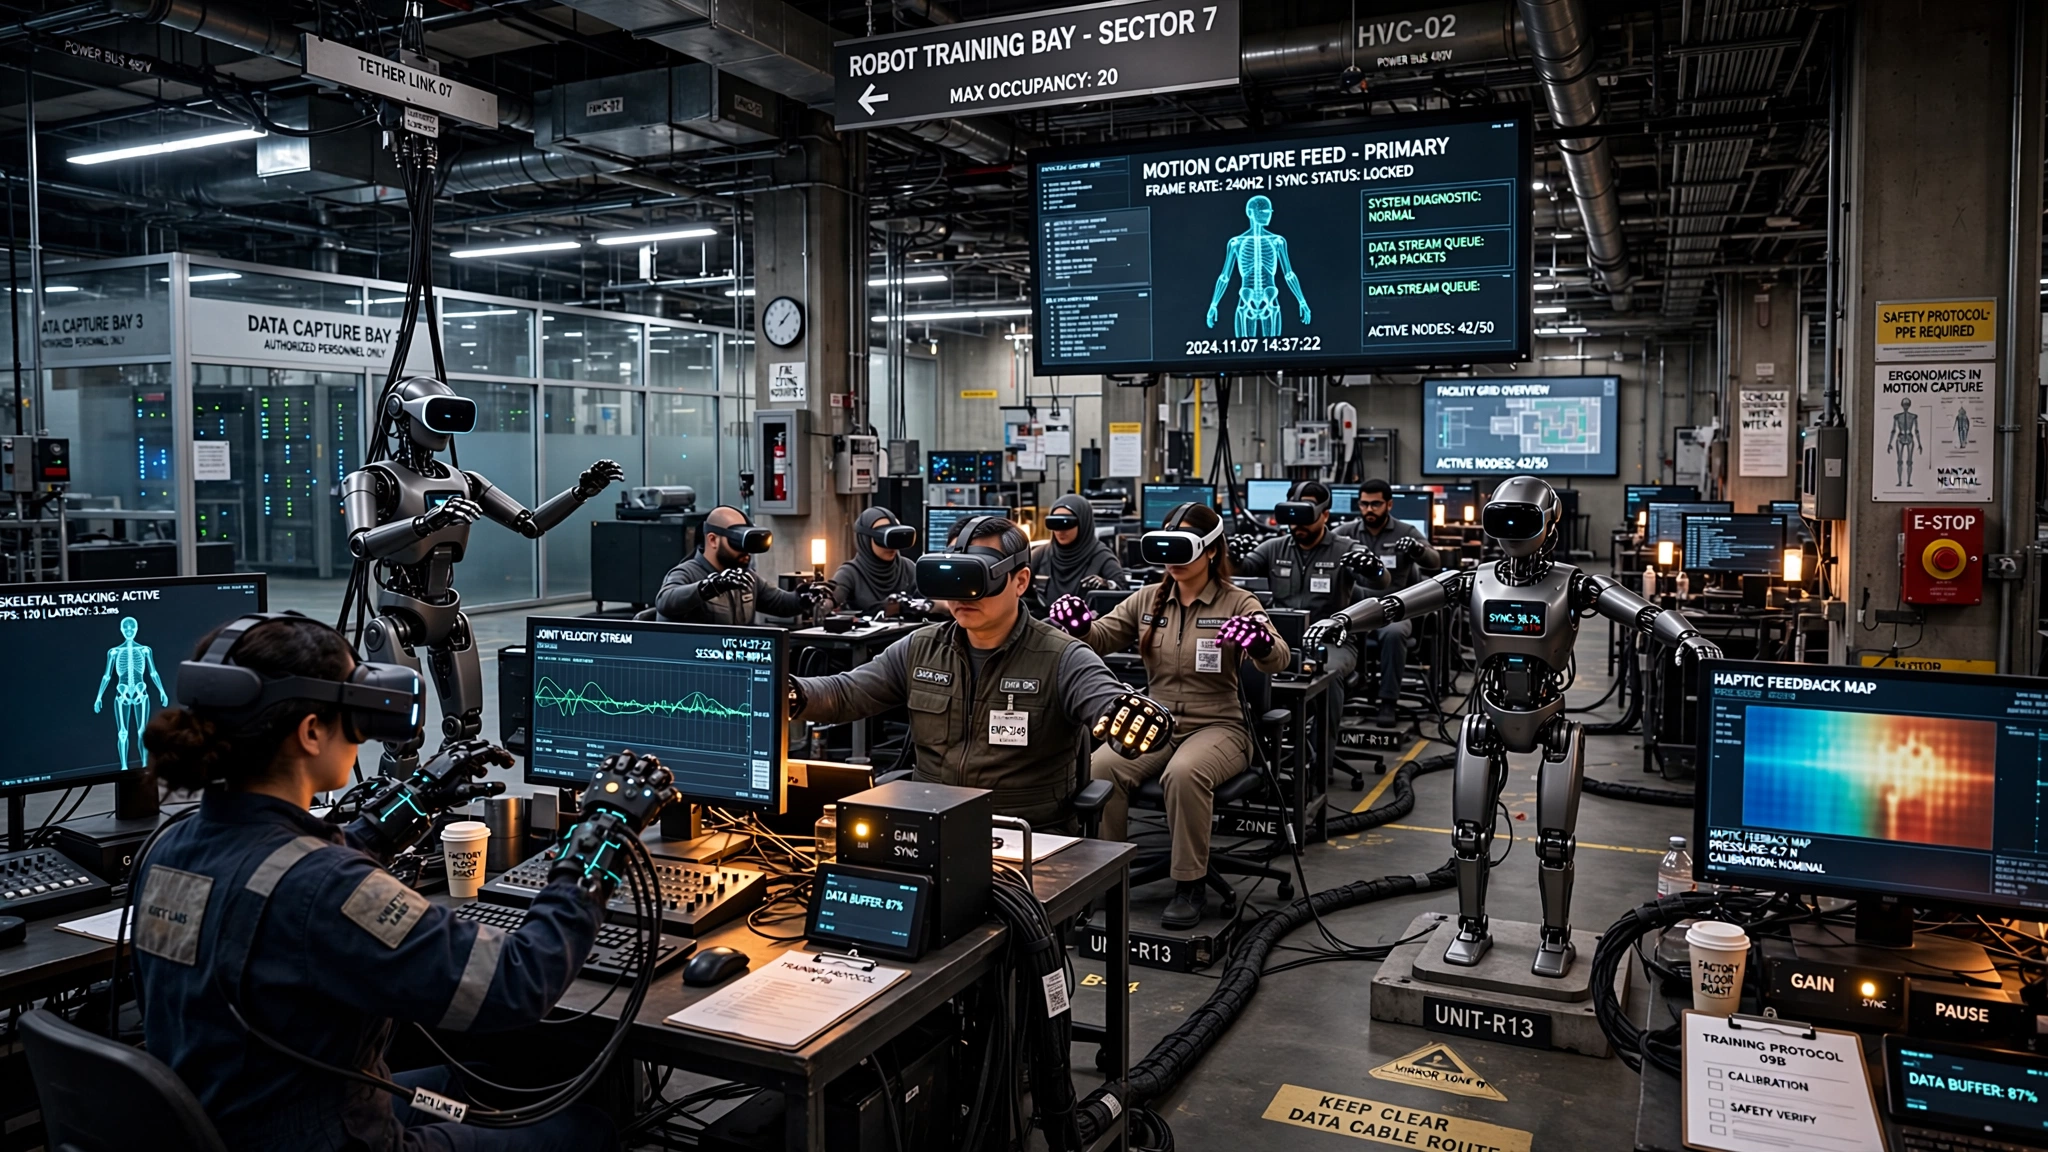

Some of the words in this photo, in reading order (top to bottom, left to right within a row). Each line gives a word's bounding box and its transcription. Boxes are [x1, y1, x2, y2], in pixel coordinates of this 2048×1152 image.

[1358, 14, 1456, 48] HVC-02
[849, 46, 918, 77] ROBOT
[922, 33, 1025, 67] TRAINING
[1031, 25, 1077, 54] BAY
[1097, 9, 1195, 46] SECTOR
[1202, 6, 1218, 31] 7
[65, 40, 101, 60] POWER
[105, 51, 125, 67] BUS
[357, 56, 406, 85] TETHER
[409, 72, 437, 94] LINK
[439, 82, 452, 98] 07
[950, 84, 984, 103] MAX
[988, 71, 1092, 99] OCCUPANCY:
[1097, 68, 1118, 86] 20
[1143, 158, 1210, 180] MOTION
[1215, 150, 1296, 172] CAPTURE
[1300, 146, 1347, 165] FEED
[1364, 137, 1450, 161] PRIMARY
[1145, 183, 1186, 197] FRAME
[1189, 180, 1223, 193] RATE:
[1275, 172, 1308, 188] SYNC
[1311, 168, 1360, 184] STATUS:
[1363, 164, 1414, 181] LOCKED
[1368, 195, 1411, 209] SYSTEM
[1412, 190, 1482, 206] DIAGNOSTIC:
[1368, 208, 1415, 222] NORMAL
[1368, 240, 1396, 253] DATA
[1398, 238, 1442, 251] STREAM
[1444, 236, 1485, 251] QUEUE:
[1368, 253, 1398, 268] 1,204
[1400, 250, 1447, 265] PACKETS
[1368, 283, 1396, 296] DATA
[1397, 281, 1440, 295] STREAM
[1441, 280, 1481, 294] QUEUE:
[41, 319, 61, 334] ATA
[62, 315, 110, 334] CAPTURE
[112, 314, 133, 331] BAY
[136, 313, 144, 329] 3
[1883, 310, 1925, 324] SAFETY
[248, 314, 289, 335] DATA
[293, 319, 361, 341] CAPTURE
[365, 326, 392, 344] BAY
[1368, 323, 1409, 338] ACTIVE
[1411, 322, 1455, 336] NODES:
[1457, 320, 1495, 335] 42/50
[1895, 326, 1916, 339] PPE
[1919, 324, 1975, 339] REQUIRED
[264, 339, 317, 353] AUTHORIZED
[318, 343, 365, 358] PERSONNEL
[366, 347, 387, 359] ONLY
[1186, 339, 1258, 356] 2024.11.07
[1261, 336, 1321, 353] 14:37:22
[1888, 370, 1966, 381] ERGONOMICS
[1969, 369, 1982, 380] IN
[1436, 385, 1475, 397] FACILITY
[1476, 385, 1500, 396] GRID
[1501, 384, 1550, 396] OVERVIEW
[1883, 382, 1928, 394] MOTION
[1930, 381, 1984, 393] CAPTURE
[1436, 457, 1473, 469] ACTIVE
[1516, 456, 1549, 469] 42/50
[1914, 514, 1976, 531] E-STOP
[0, 594, 57, 608] SKELETAL
[58, 592, 120, 605] TRACKING:
[122, 589, 160, 601] ACTIVE
[0, 610, 20, 621] FPS:
[23, 609, 41, 620] 120
[47, 607, 92, 618] LATENCY:
[93, 605, 120, 616] 3.2ms
[536, 629, 560, 640] JOINT
[560, 630, 599, 642] VELOCITY
[600, 632, 633, 645] STREAM
[722, 637, 738, 649] UTC
[1714, 673, 1764, 688] HAPTIC
[1767, 676, 1841, 693] FEEDBACK
[1844, 680, 1877, 694] MAP
[1235, 818, 1278, 835] ZONE
[893, 829, 918, 844] GAIN
[1709, 829, 1742, 841] HAPTIC
[1791, 837, 1812, 849] MAP
[448, 849, 483, 860] FACTORY
[893, 845, 919, 859] SYNC
[1770, 846, 1788, 857] 4.7
[1789, 848, 1798, 858] N
[1709, 852, 1777, 869] CALIBRATION:
[1778, 859, 1826, 874] NOMINAL
[825, 888, 848, 905] DATA
[849, 892, 884, 909] BUFFER:
[885, 898, 904, 912] 87%
[1091, 935, 1172, 963] U-R13
[1698, 959, 1741, 974] FACTORY
[1702, 972, 1734, 985] FLOOR
[1790, 972, 1835, 993] GAIN
[1701, 982, 1733, 997] ROAST
[1861, 998, 1887, 1009] SYNC
[1935, 1001, 1989, 1023] PAUSE
[1434, 1004, 1534, 1038] UNIT-R13
[1702, 1033, 1766, 1051] TRAINING
[1769, 1043, 1844, 1063] PROTOCOL
[1759, 1054, 1787, 1066] 09B
[1728, 1071, 1809, 1092] CALIBRATION
[1908, 1072, 1945, 1089] DATA
[1947, 1078, 2005, 1098] BUFFER:
[2007, 1087, 2038, 1103] 87%
[1318, 1095, 1373, 1116] KEEP
[1380, 1108, 1450, 1132] CLEAR
[1730, 1102, 1773, 1117] SAFETY
[1776, 1109, 1817, 1125] VERIFY
[1287, 1107, 1341, 1130] DATA
[1349, 1120, 1419, 1145] CABLE
